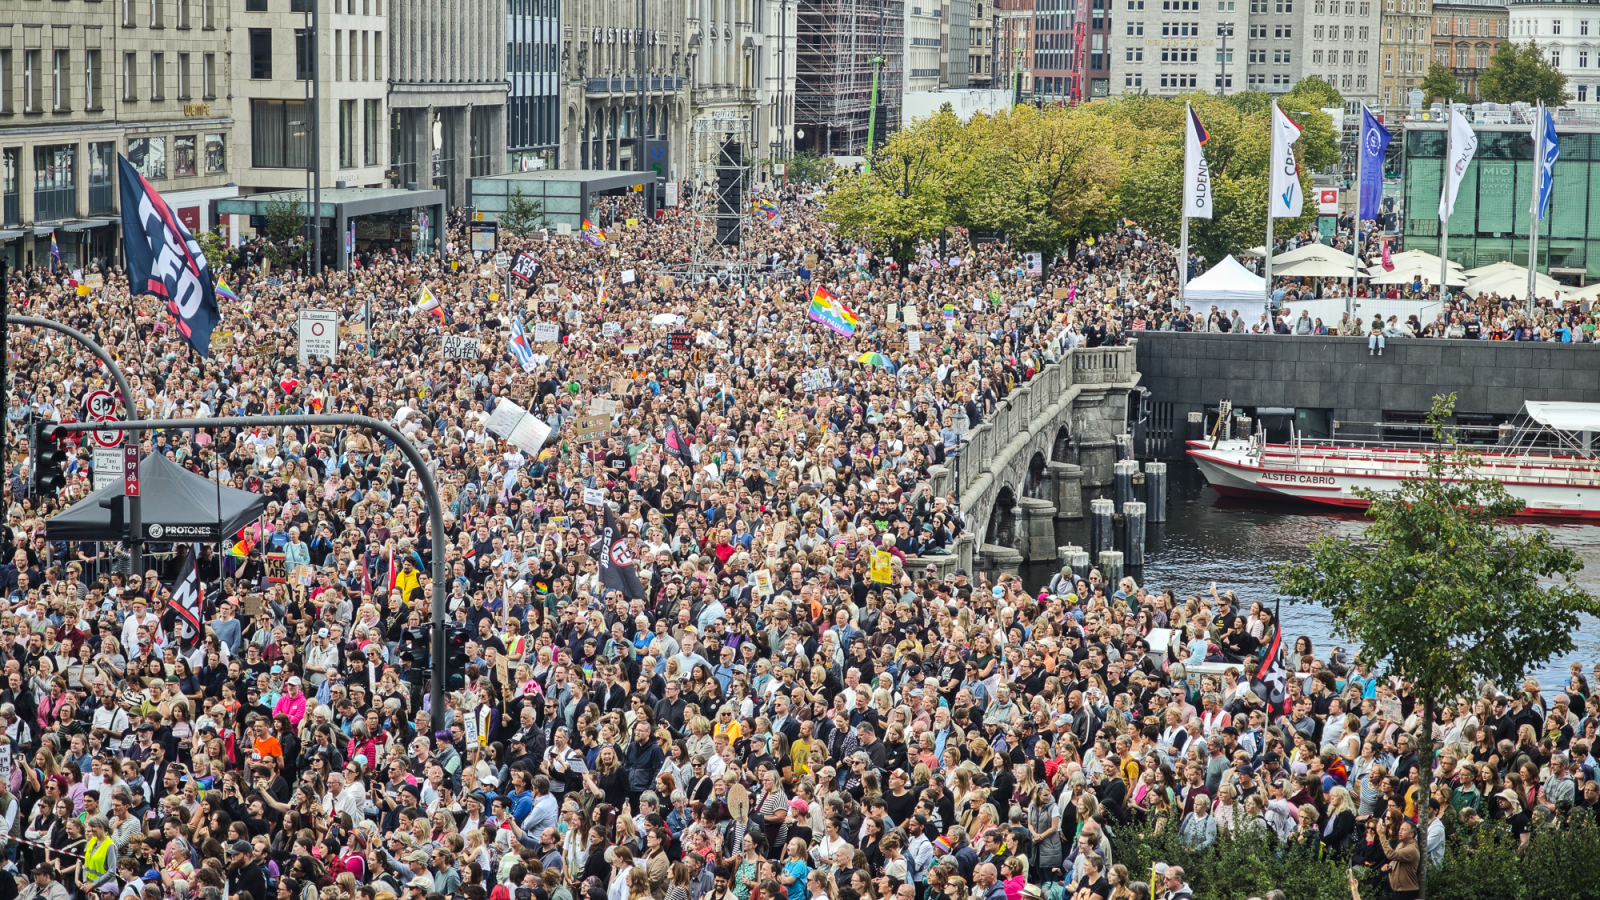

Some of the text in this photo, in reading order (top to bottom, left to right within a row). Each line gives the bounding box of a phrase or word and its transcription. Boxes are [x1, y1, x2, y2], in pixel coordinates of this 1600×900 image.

[1146, 39, 1214, 47] PRIEN-HAUS
[184, 103, 211, 116] WEMPE
[652, 146, 663, 159] U
[652, 162, 662, 175] S
[517, 254, 540, 272] FCK
[512, 263, 533, 278] AFD
[1262, 472, 1335, 485] ALSTER CABRIO
[165, 526, 211, 534] PROTONES
[268, 559, 285, 569] FCK
[268, 568, 286, 578] AFD
